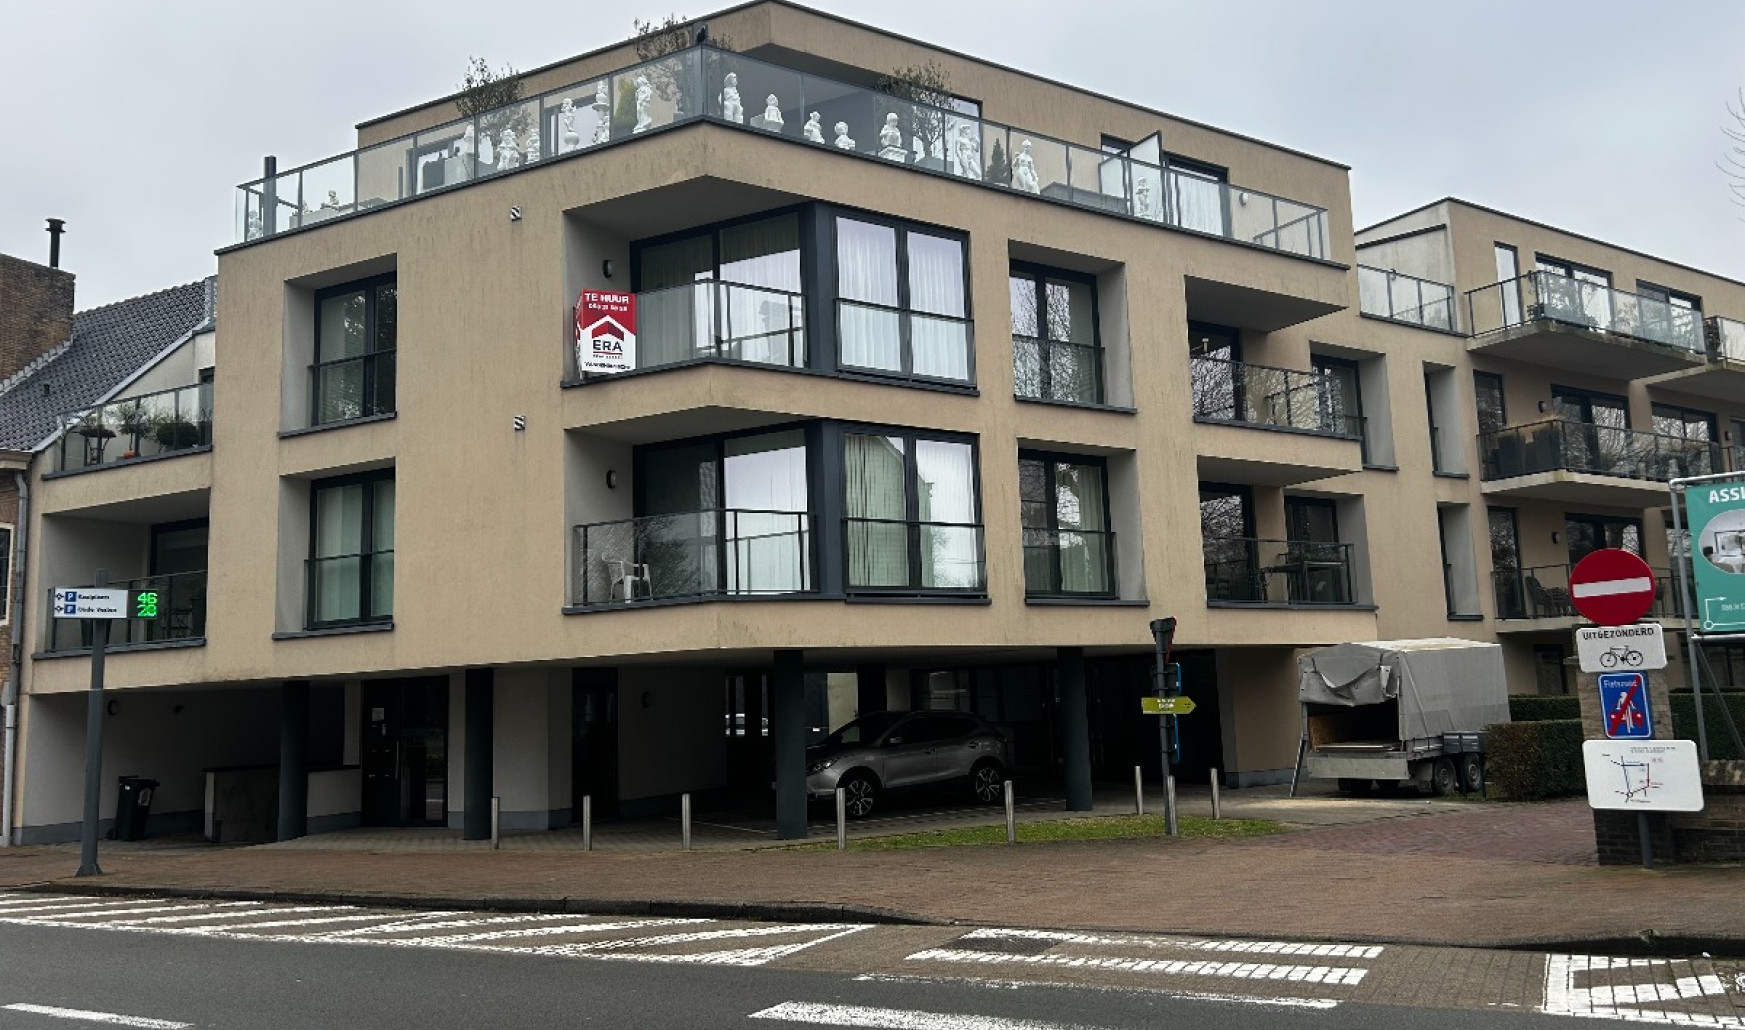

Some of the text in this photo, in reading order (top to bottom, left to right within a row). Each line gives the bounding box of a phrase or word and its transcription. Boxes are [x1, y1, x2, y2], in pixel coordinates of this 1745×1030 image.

[584, 292, 629, 304] TE HUUR
[593, 339, 623, 352] ERA
[137, 592, 158, 604] 46
[1582, 627, 1655, 640] UITGEZONDERD
